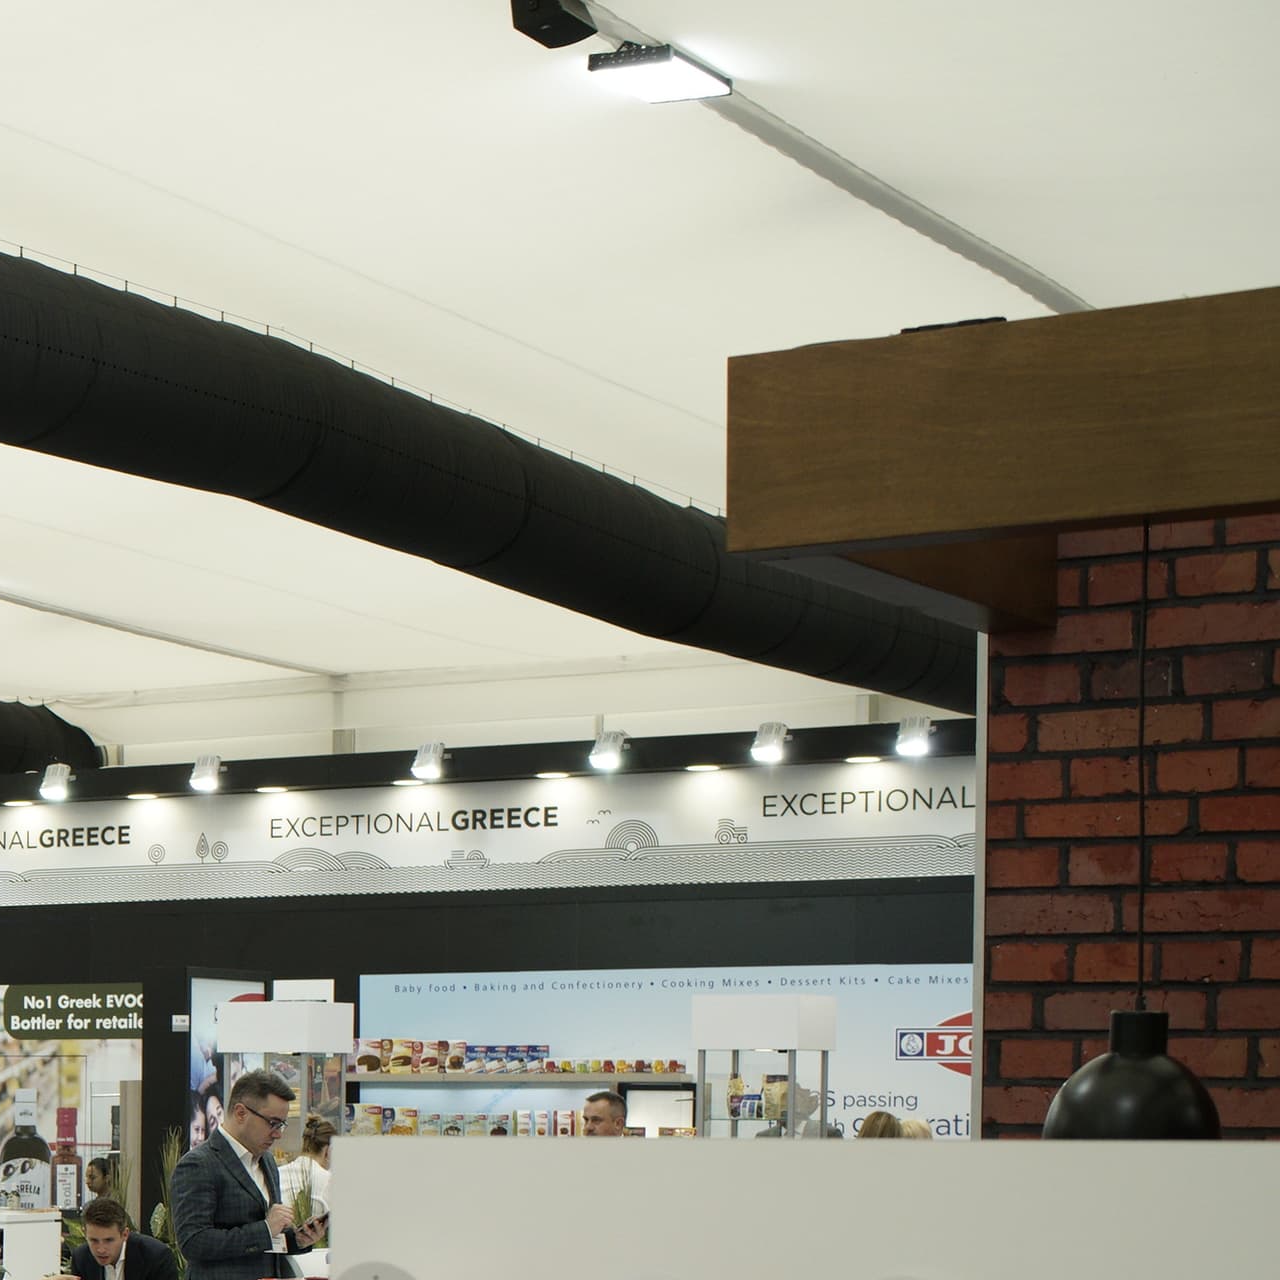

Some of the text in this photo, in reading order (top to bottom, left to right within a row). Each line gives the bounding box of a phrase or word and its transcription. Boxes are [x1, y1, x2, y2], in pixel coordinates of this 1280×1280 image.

[761, 785, 976, 818] EXCEPTIONAL
[394, 974, 969, 994] Baby food Baking and Confectionery Cooking Mixes Dessert Kits Cake Mixes
[23, 995, 52, 1009] No1
[57, 993, 102, 1009] Greek
[10, 1014, 63, 1030] Bottler
[67, 1012, 91, 1029] for
[843, 1091, 918, 1110] passing
